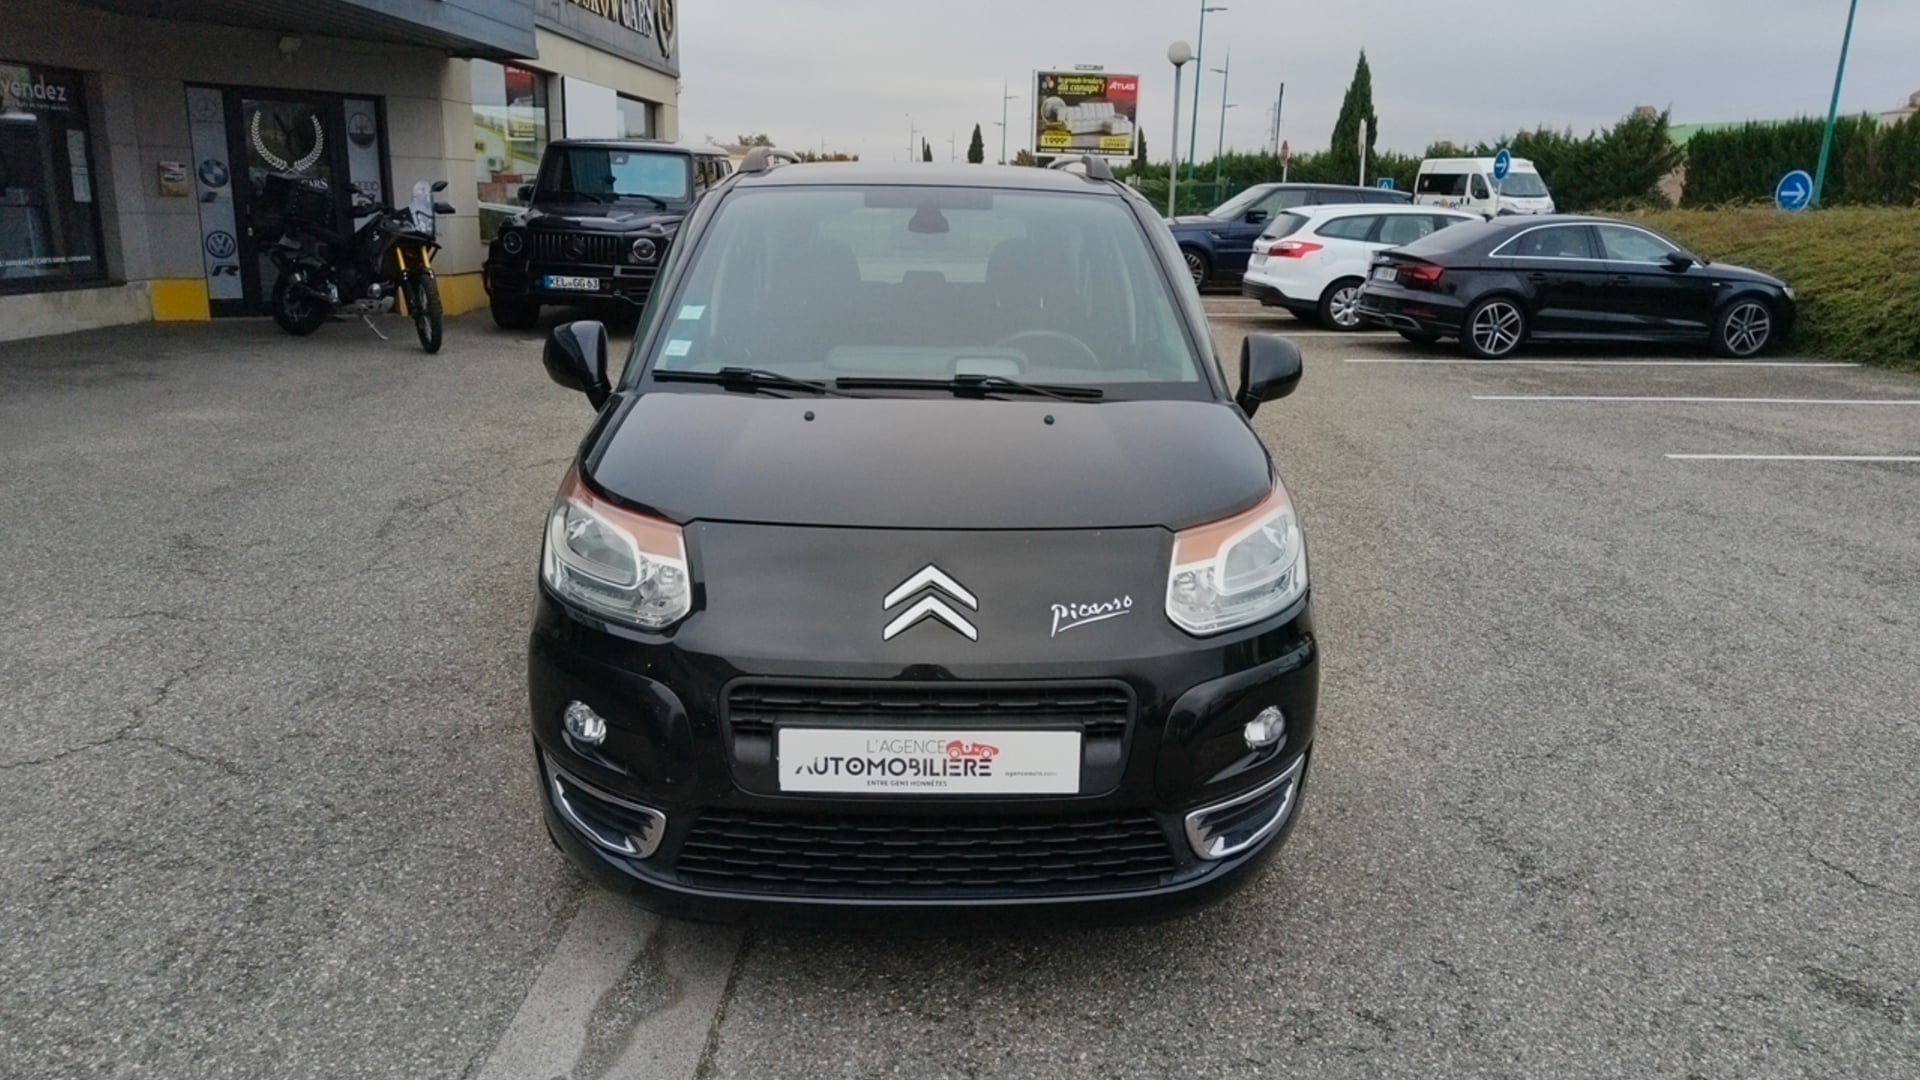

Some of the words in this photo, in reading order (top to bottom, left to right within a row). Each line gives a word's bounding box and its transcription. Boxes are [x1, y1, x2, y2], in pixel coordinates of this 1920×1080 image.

[866, 739, 946, 754] L'AGENCE
[866, 779, 888, 787] ENTRE
[890, 779, 909, 787] GENS
